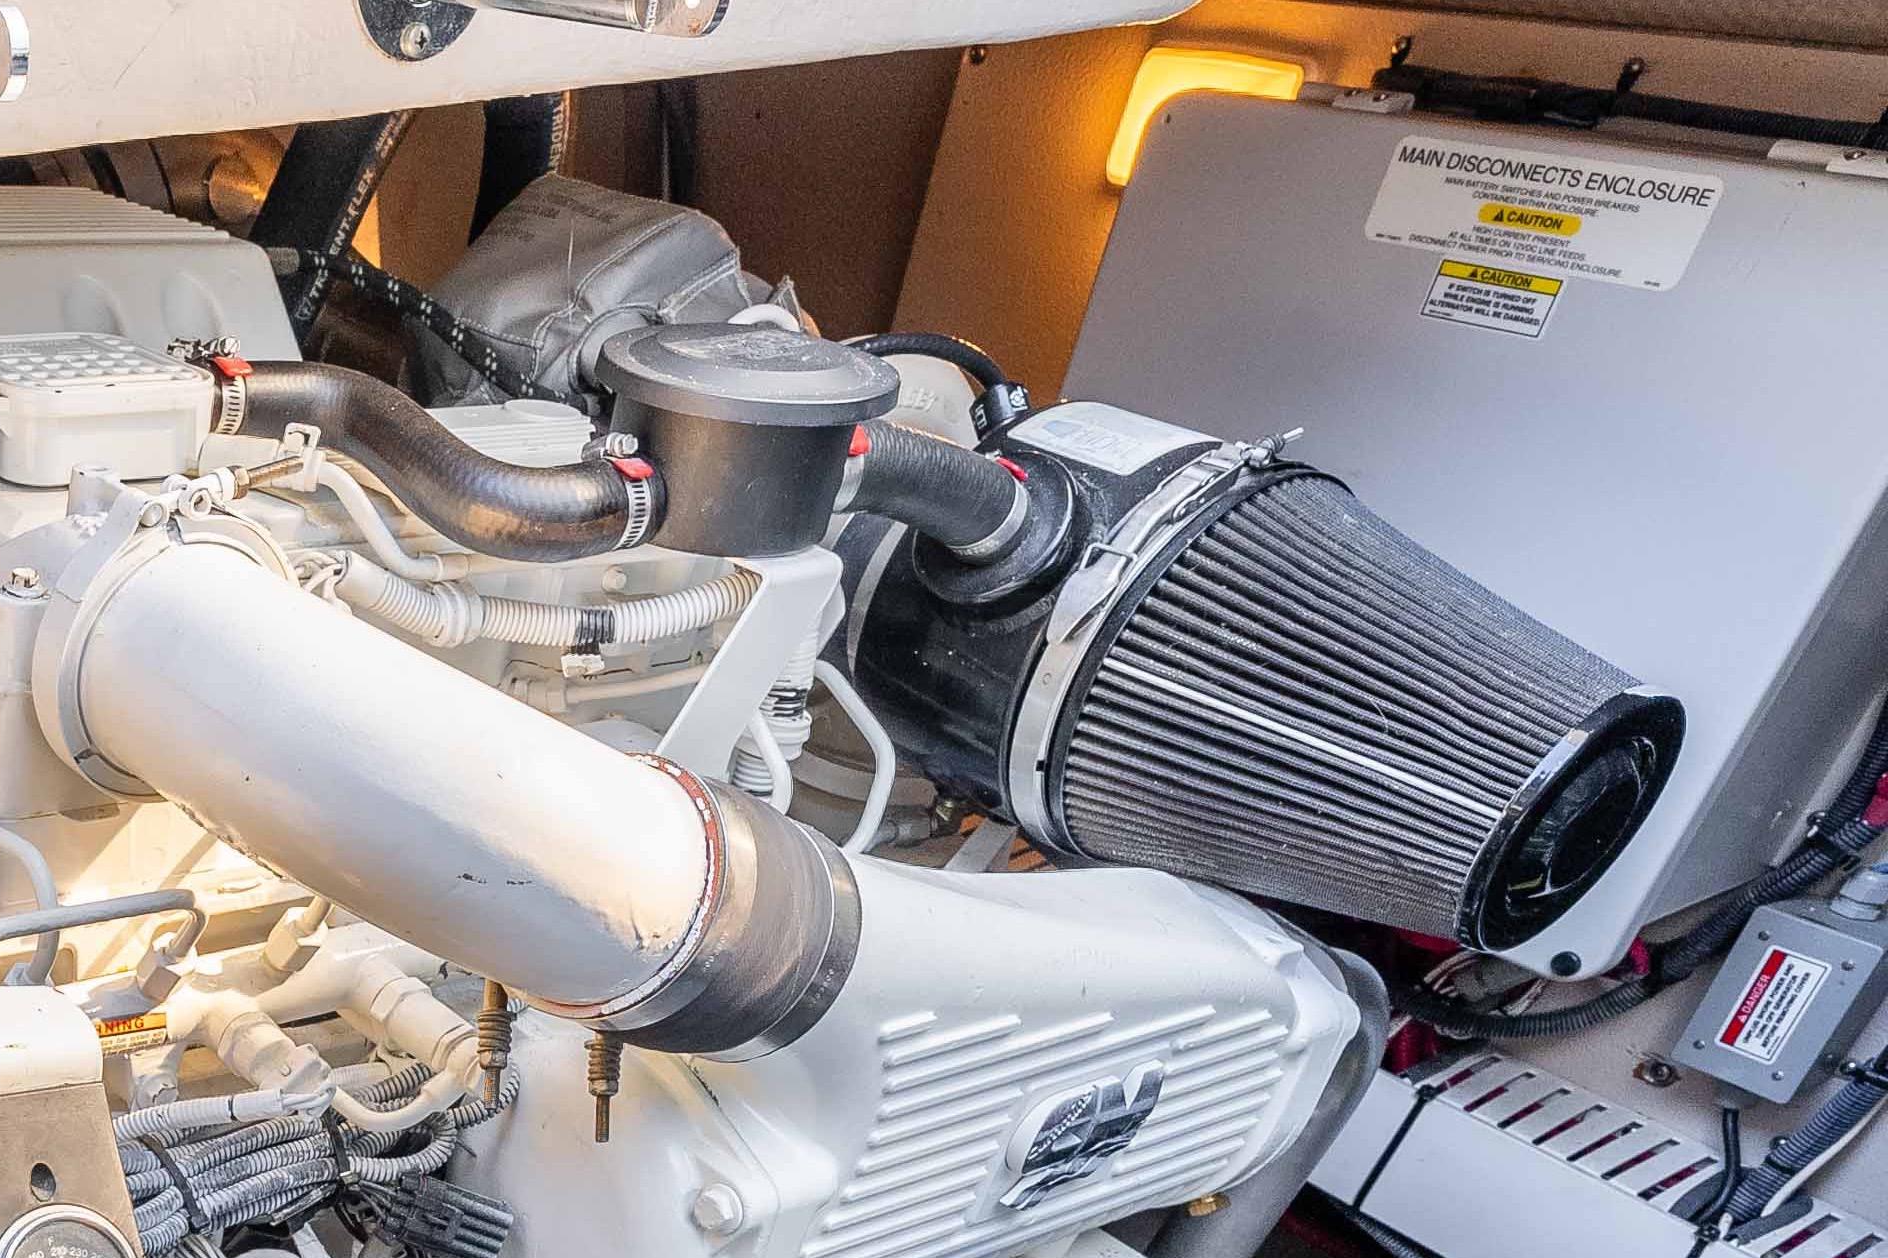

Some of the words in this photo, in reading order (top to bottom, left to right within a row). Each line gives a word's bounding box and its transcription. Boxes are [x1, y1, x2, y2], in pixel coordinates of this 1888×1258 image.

[1398, 146, 1445, 168] MAIN
[1446, 153, 1583, 187] DISCONNECTS
[1585, 172, 1715, 207] ENCLOSURE
[1466, 180, 1498, 191] BATTERY
[1501, 185, 1542, 197] SWITCHES
[1563, 194, 1593, 206] POWER
[1595, 200, 1640, 213] BREAKERS
[1472, 191, 1517, 203] CONTAINED
[1507, 210, 1564, 229] CAUTION
[1460, 233, 1471, 242] ALL
[1474, 235, 1497, 246] TIMES
[1492, 228, 1531, 241] CURRENT
[1532, 233, 1570, 247] PRESENT
[1409, 234, 1457, 247] DISCONNECT
[1458, 242, 1486, 253] POWER
[1488, 247, 1512, 258] PRIOR
[1526, 254, 1569, 268] SERVICING
[1481, 271, 1533, 288] CAUTION
[1456, 284, 1483, 295] SWITCH
[1493, 291, 1521, 303] TURNED
[1429, 299, 1472, 312] ALTERNATOR
[1444, 292, 1464, 303] WHILE
[1466, 295, 1492, 307] ENGINE
[1501, 303, 1534, 315] RUNNING
[1742, 974, 1771, 1013] DANGER
